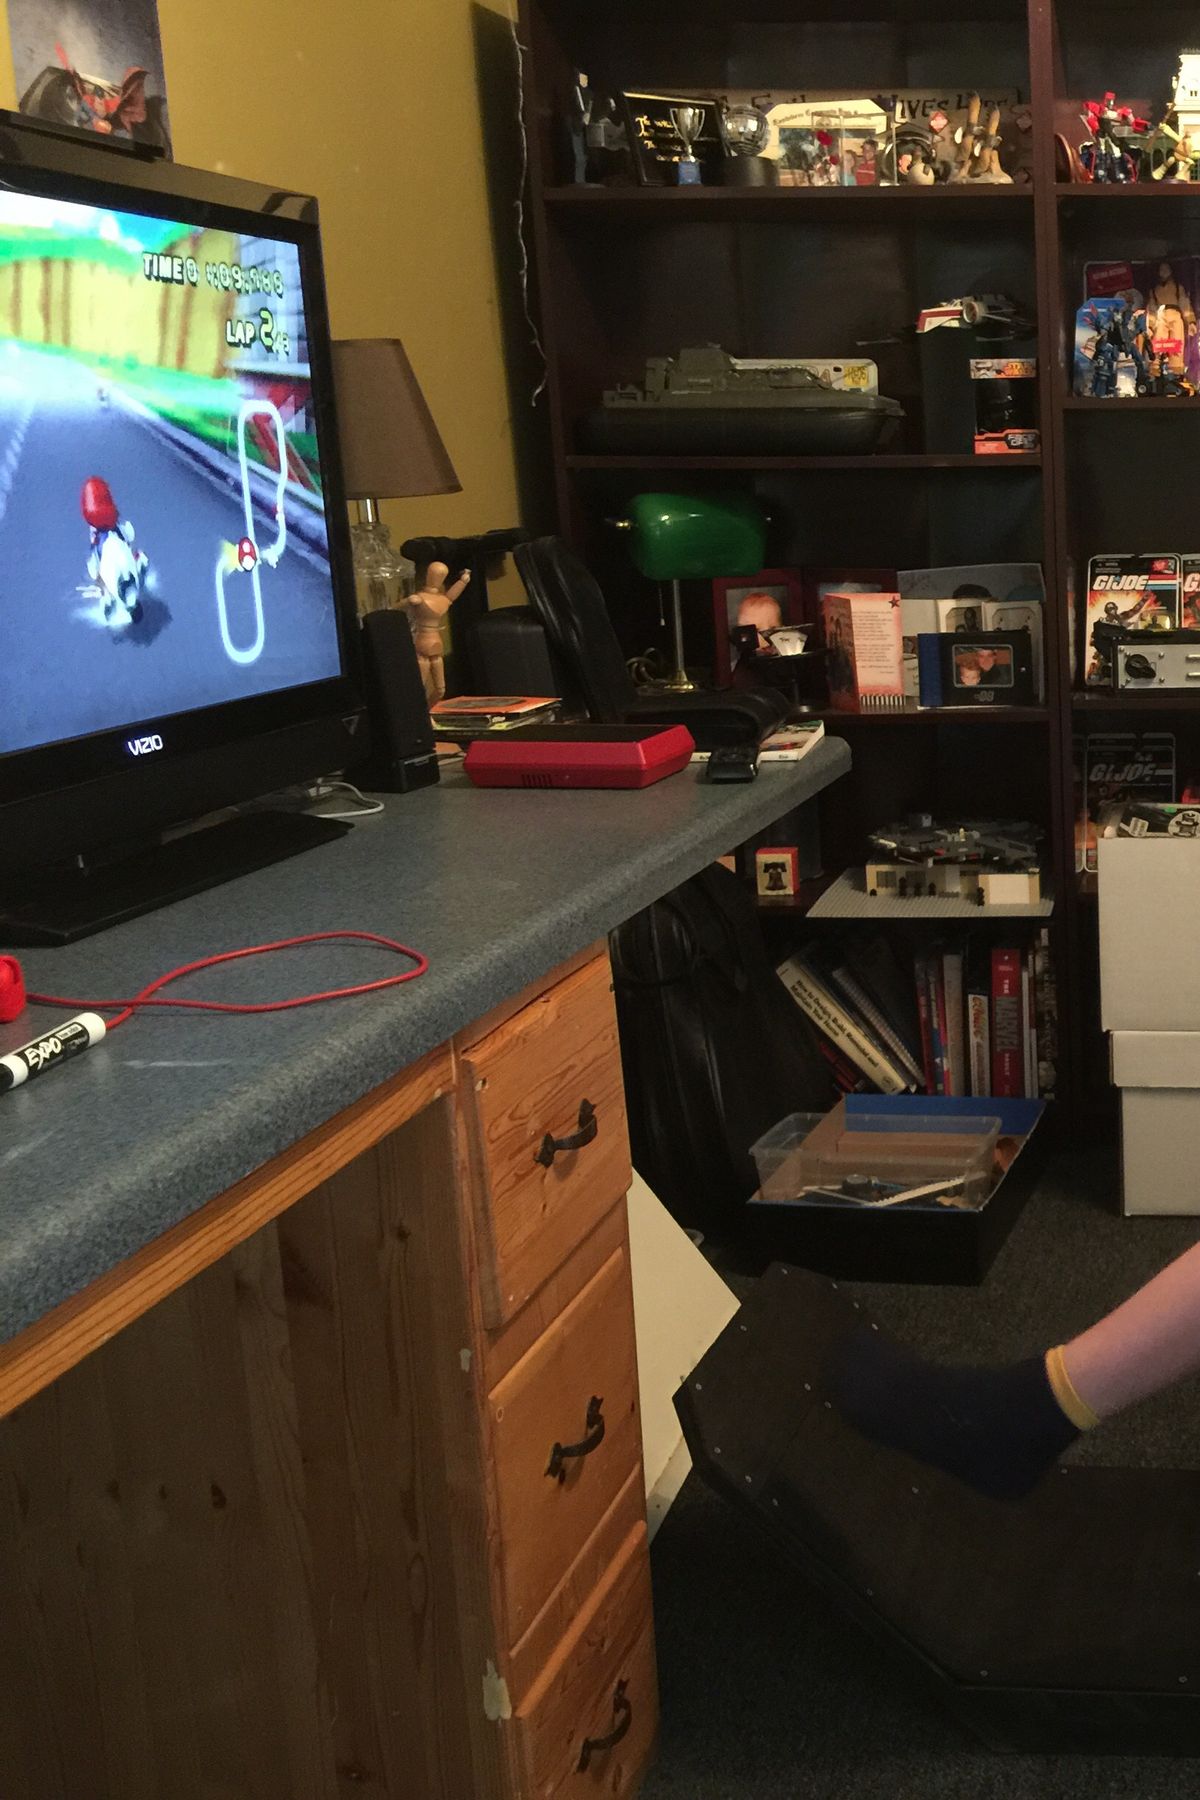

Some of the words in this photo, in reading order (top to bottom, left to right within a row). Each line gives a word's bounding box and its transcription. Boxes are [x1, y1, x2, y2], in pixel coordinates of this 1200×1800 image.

[143, 252, 184, 284] TIME
[226, 319, 256, 348] LAP
[128, 735, 163, 756] VIZIO
[790, 984, 813, 1010] Maintain
[823, 1020, 840, 1037] Home
[995, 997, 1019, 1052] MARVEL
[24, 1037, 62, 1070] EXPO
